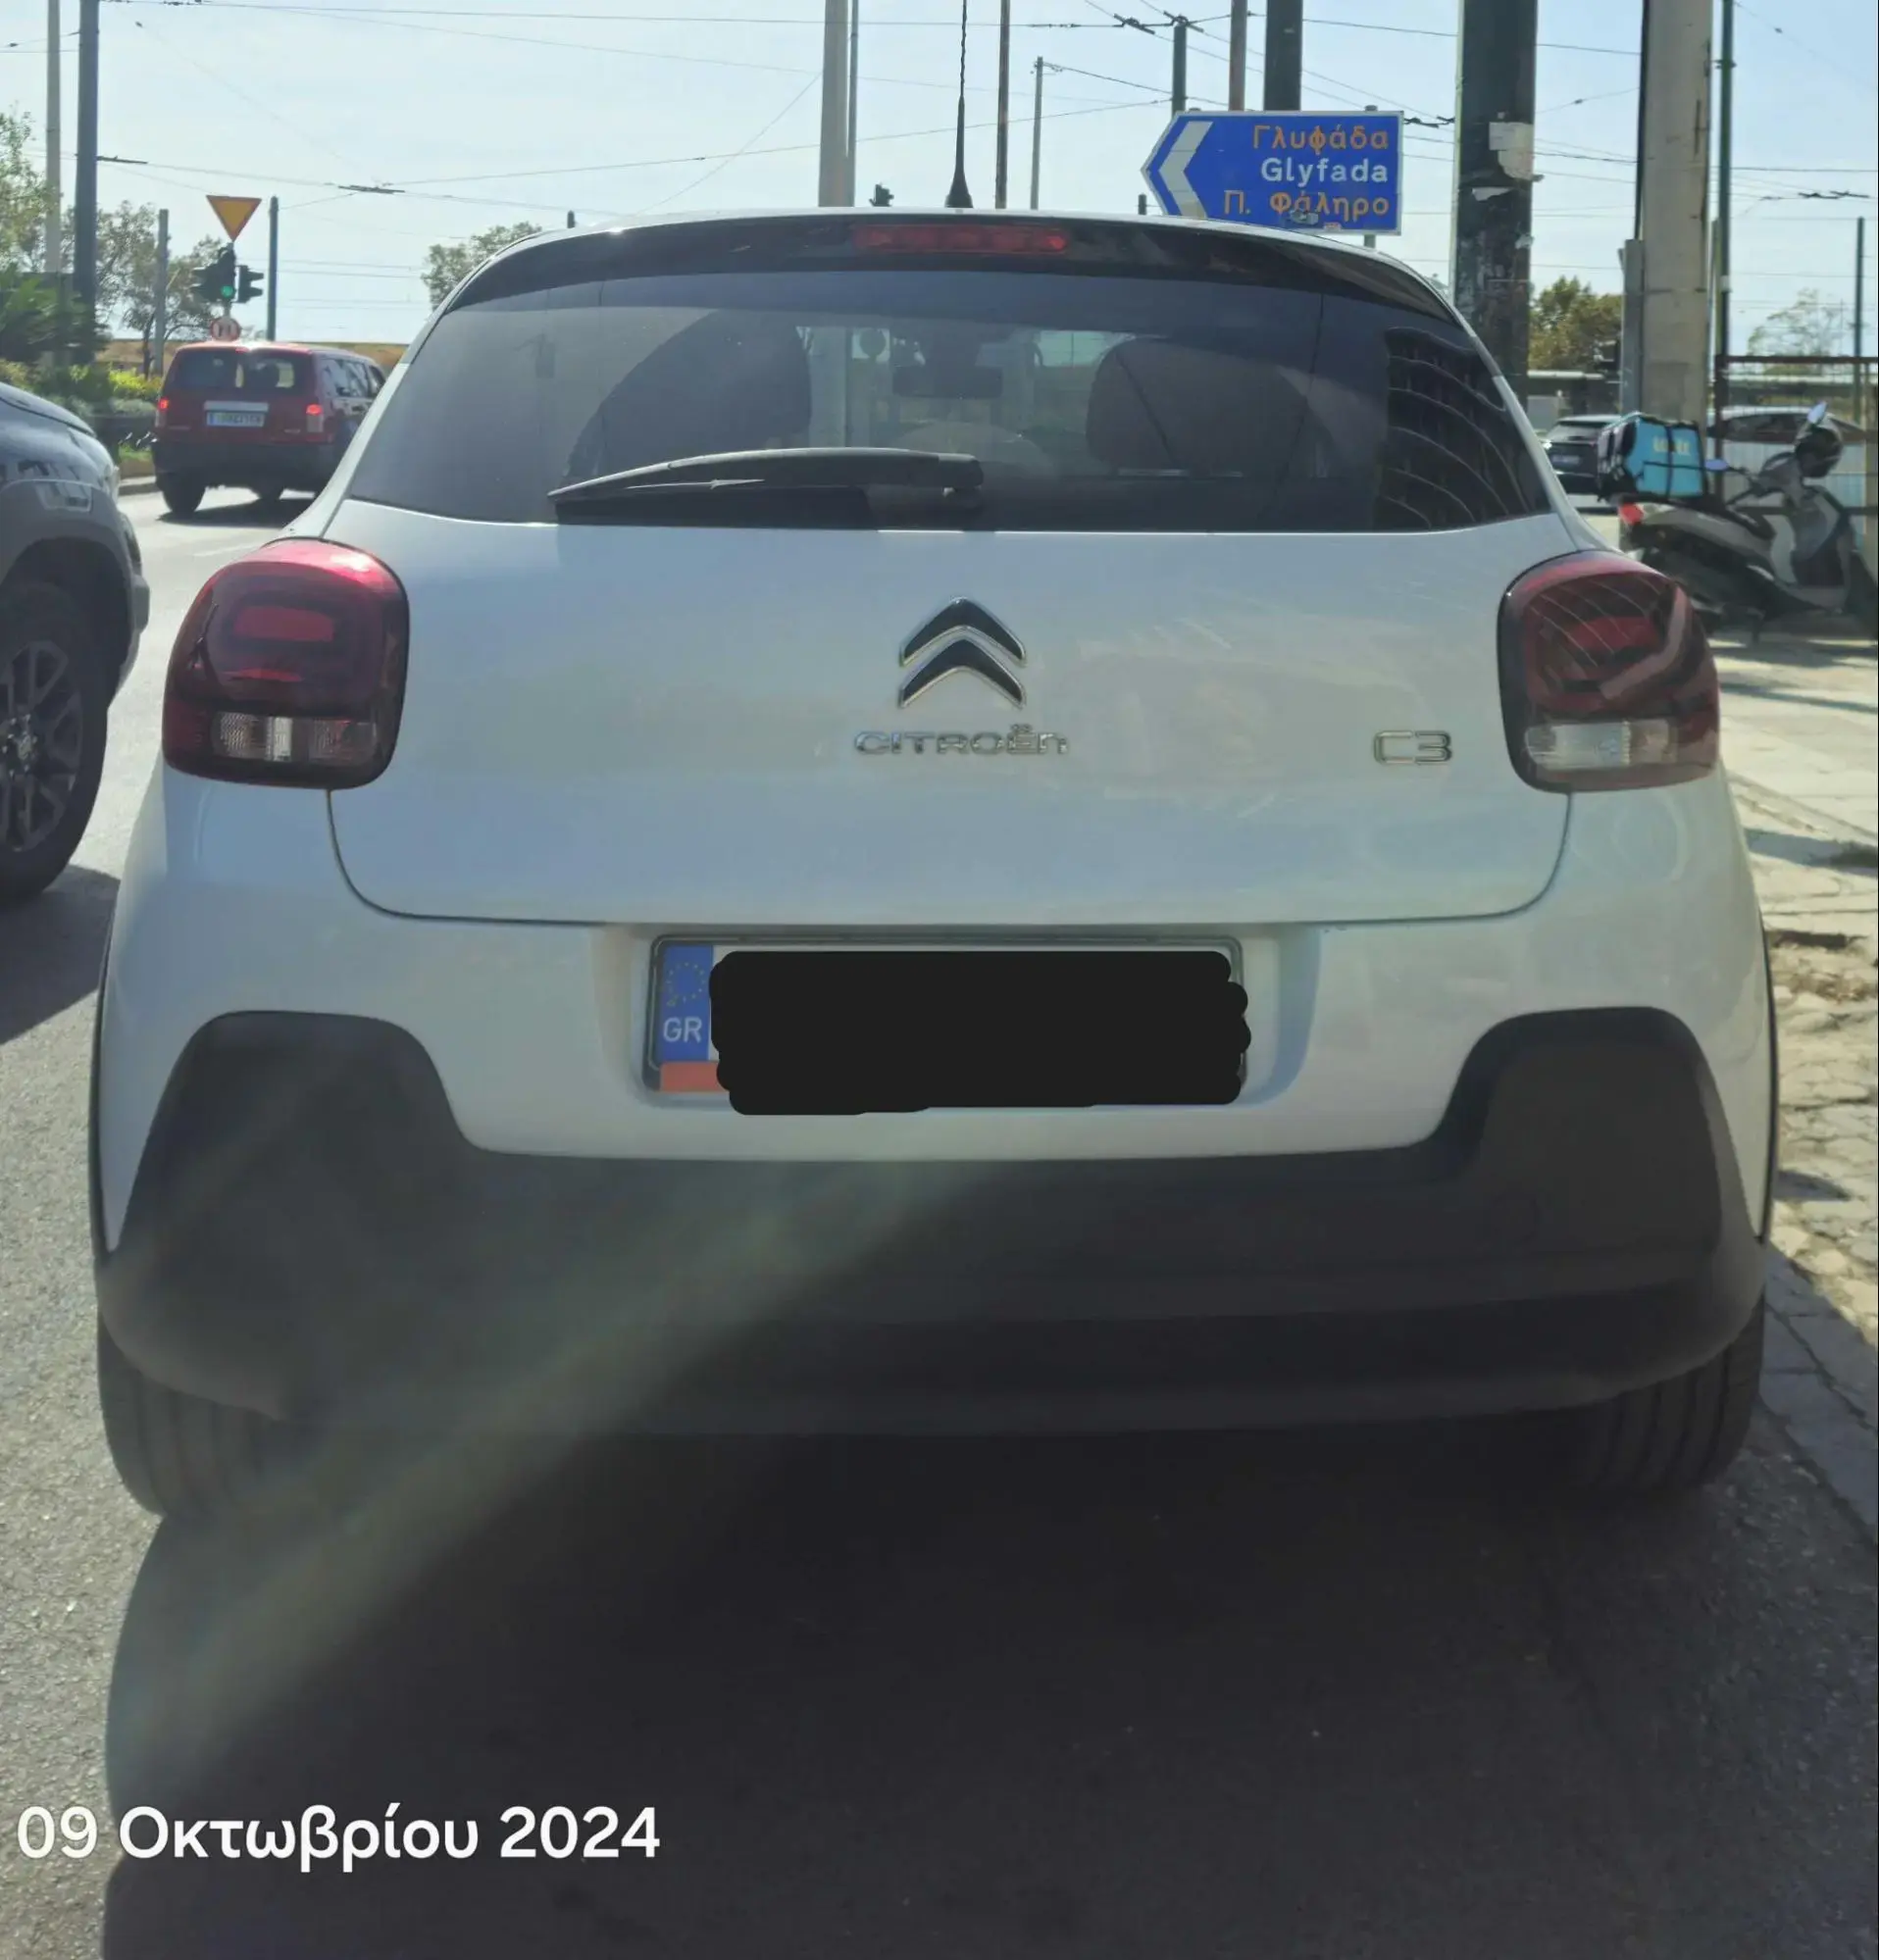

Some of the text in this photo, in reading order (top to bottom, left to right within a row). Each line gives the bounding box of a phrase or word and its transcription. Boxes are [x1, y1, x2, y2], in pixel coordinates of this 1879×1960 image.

[1252, 125, 1389, 155] Γλυφάδα
[1260, 157, 1389, 187] Glyfada
[1224, 190, 1390, 223] Π. Φάληρο
[1372, 729, 1452, 765] C3
[663, 1016, 703, 1043] GR
